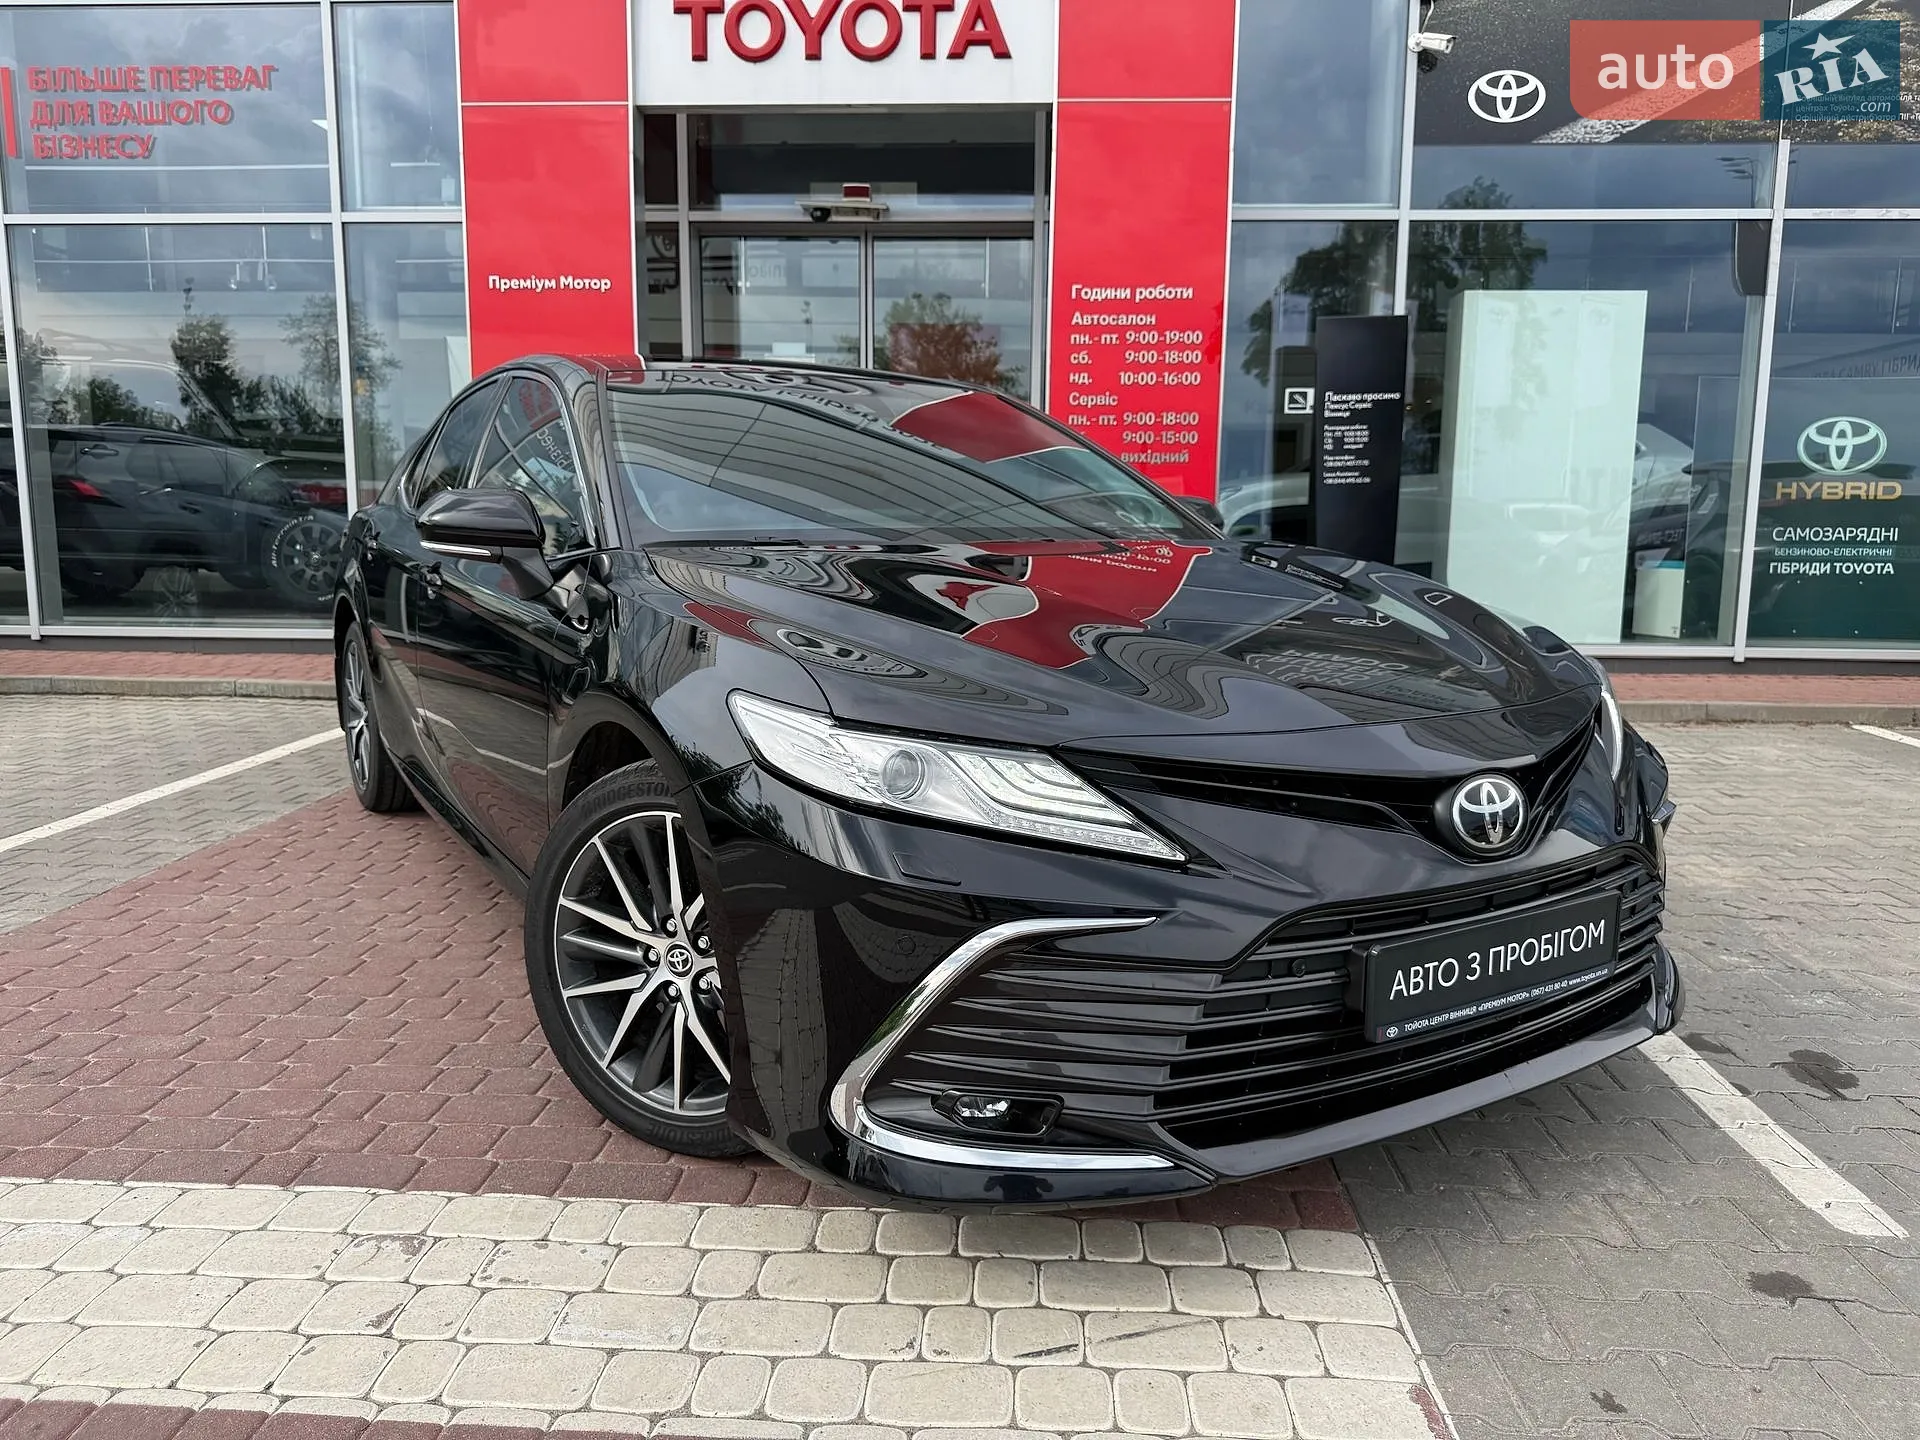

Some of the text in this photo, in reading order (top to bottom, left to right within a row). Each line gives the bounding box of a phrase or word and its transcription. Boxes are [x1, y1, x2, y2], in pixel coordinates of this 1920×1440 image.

[672, 0, 1012, 62] TOYOTA
[28, 65, 276, 91] БІЛЬШЕ ПЕРЕВАГ
[31, 100, 234, 128] ДЛЯ ВАШОГО
[33, 134, 153, 158] БІЗНЕСУ
[488, 273, 612, 293] Преміум Мотор
[1071, 284, 1194, 303] Години роботи
[1071, 311, 1156, 326] Автосалон
[1125, 330, 1203, 345] 9:00-19:00
[1070, 350, 1202, 364] сб. 9:00-18:00
[1069, 371, 1201, 385] нд. 10:00-16:00
[1069, 391, 1118, 407] Сервіс
[1123, 412, 1199, 426] 9:00-18:00
[1122, 431, 1198, 444] 9:00-15:00
[1121, 449, 1189, 465] вихідний
[1776, 481, 1902, 500] HYBRID
[1772, 526, 1898, 543] САМОЗАРЯДНІ
[1775, 547, 1892, 557] БЕНЗИНОВО-ЕЛЕКТРИЧНІ
[1769, 562, 1894, 576] ГІБРИДИ TOYOTA
[1389, 958, 1459, 1000] АВТО
[1488, 919, 1606, 975] ПРОБІГОМ
[1404, 1018, 1429, 1032] ТОЙОТА
[1429, 1013, 1450, 1025] ЦЕНТР
[1449, 1005, 1477, 1020] ВІННИЦЯ
